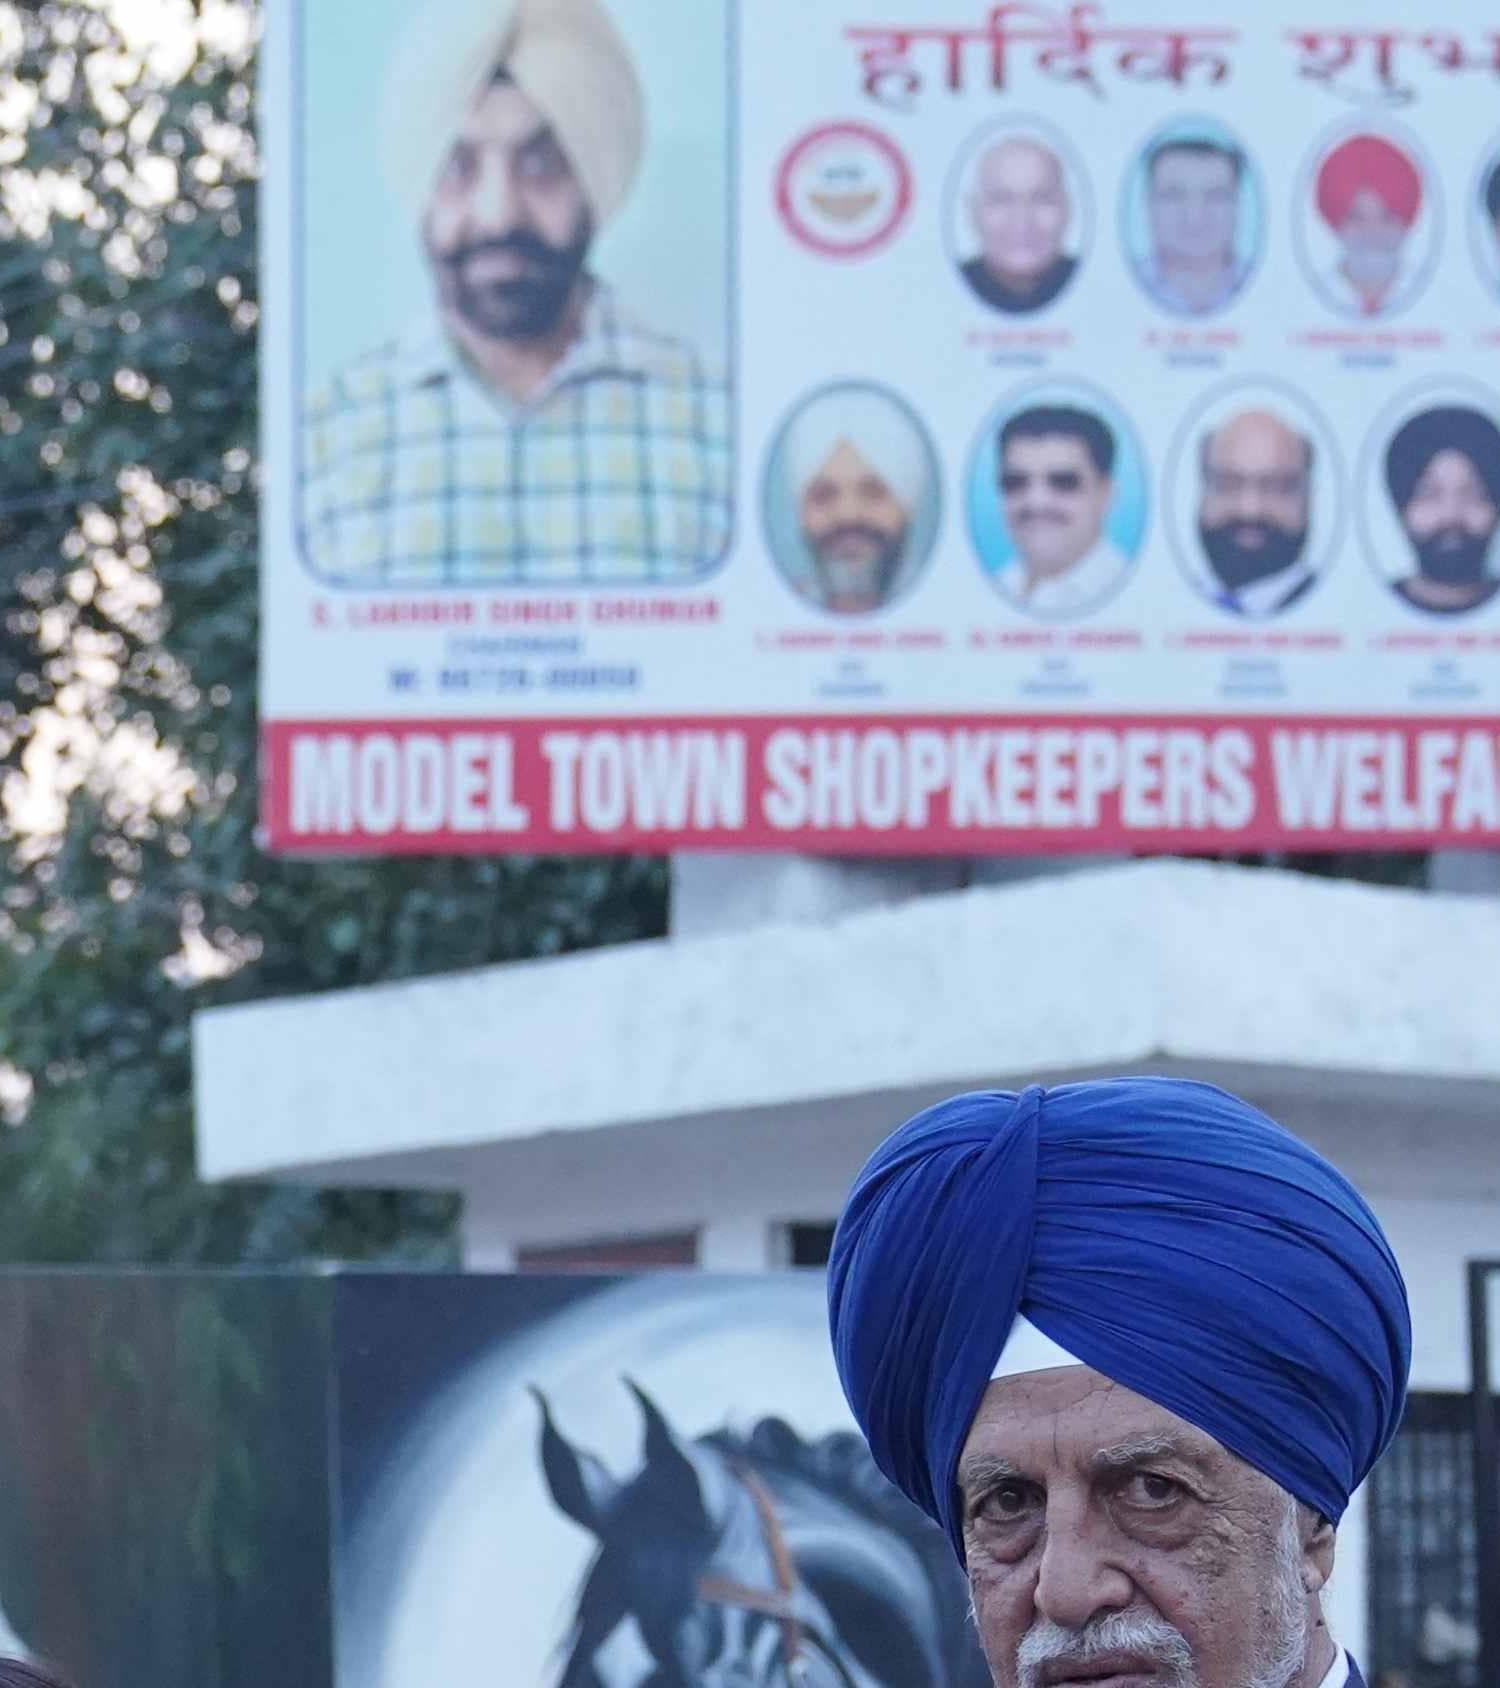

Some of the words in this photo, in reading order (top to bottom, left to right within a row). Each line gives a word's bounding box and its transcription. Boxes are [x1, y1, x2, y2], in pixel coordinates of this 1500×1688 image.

[845, 3, 1237, 112] हार्दिक
[290, 733, 528, 832] MODEL
[541, 731, 746, 831] TOWN
[763, 728, 1255, 831] SHOPKEEPERS
